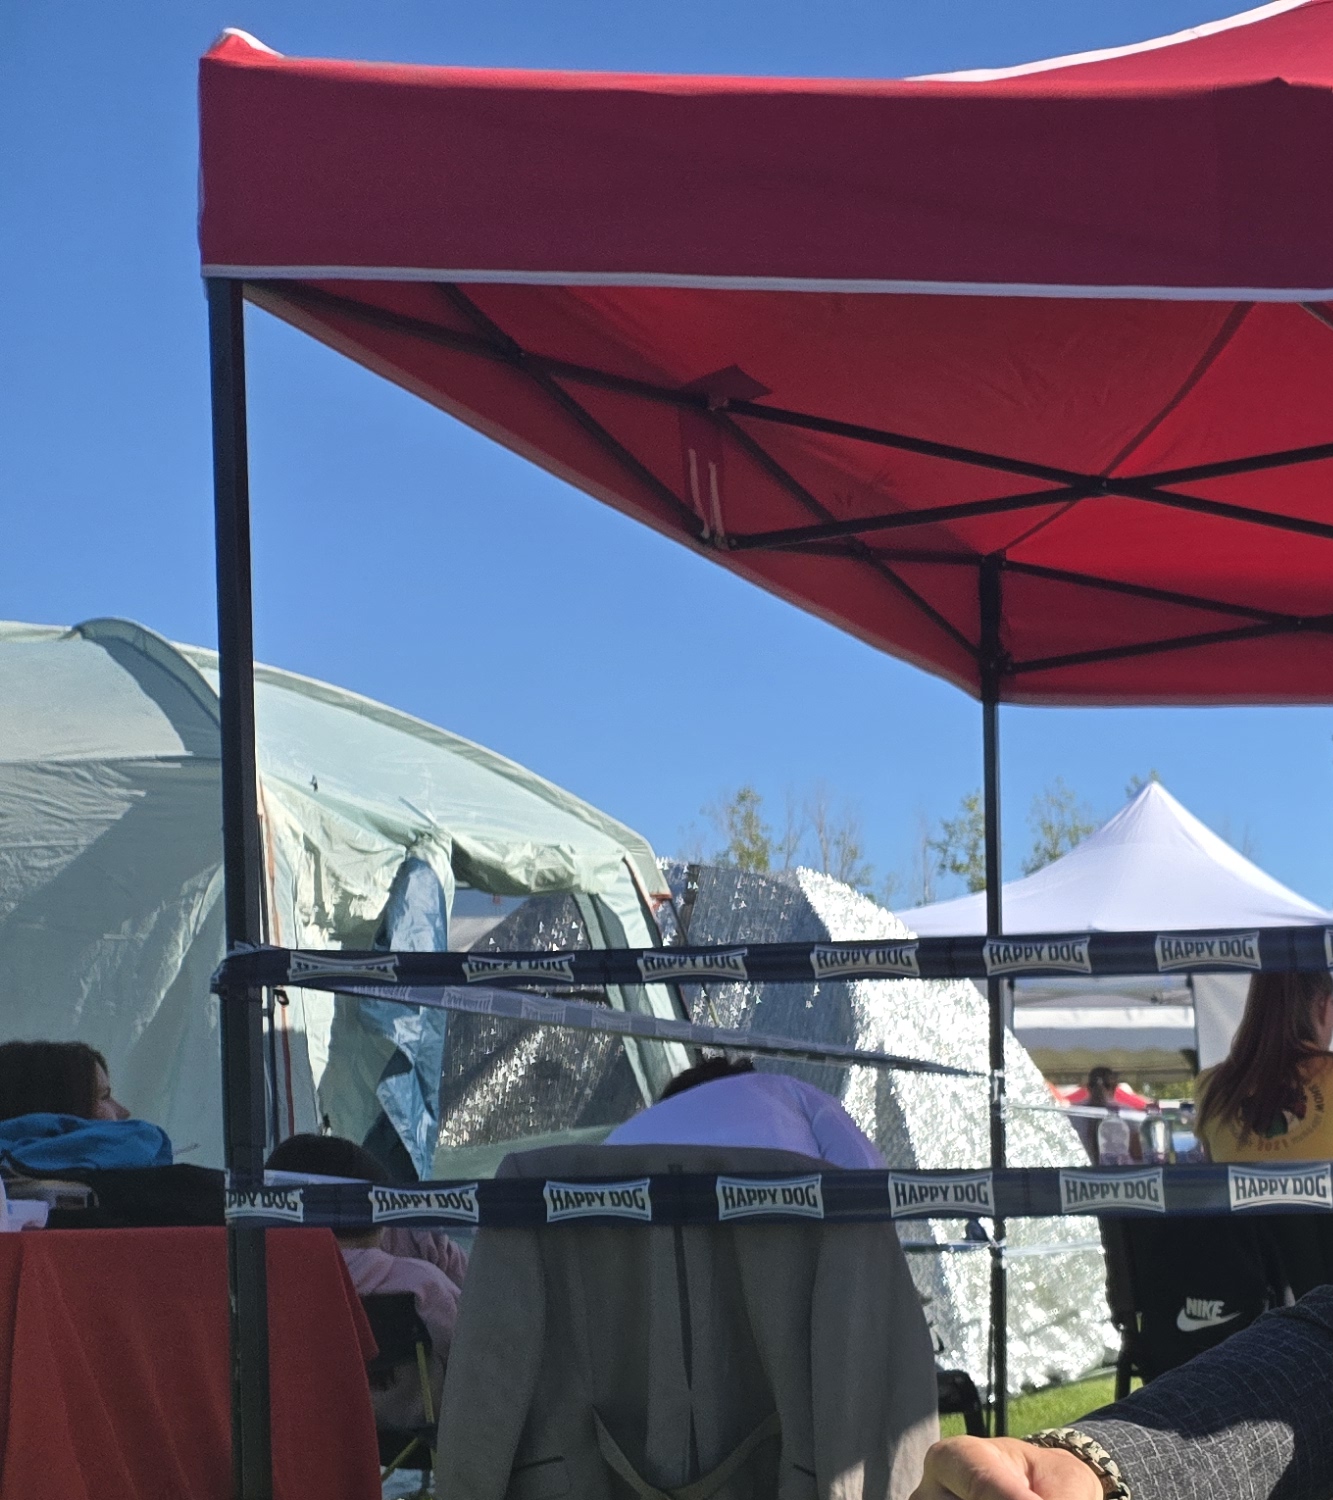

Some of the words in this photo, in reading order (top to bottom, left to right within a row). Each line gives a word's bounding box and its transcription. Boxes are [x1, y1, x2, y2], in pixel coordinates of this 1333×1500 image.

[816, 950, 872, 970] HAPPY
[875, 949, 912, 968] DOG
[989, 942, 1048, 966] HAPPY
[1049, 943, 1084, 964] DOG
[1160, 938, 1217, 962] HAPPY
[1219, 937, 1255, 960] DOG
[720, 1185, 778, 1209] HAPPY
[781, 1184, 818, 1208] DOG
[893, 1181, 949, 1208] HAPPY
[953, 1181, 989, 1206] DOG
[1064, 1178, 1121, 1204] HAPPY
[1123, 1178, 1159, 1202] DOG
[1234, 1176, 1291, 1201] HAPPY
[1292, 1174, 1327, 1198] DOG
[374, 1190, 435, 1213] HAPPY
[438, 1190, 474, 1212] DOG
[550, 1189, 605, 1212] HAPPY
[608, 1188, 646, 1211] DOG
[1186, 1297, 1225, 1320] NIKE
